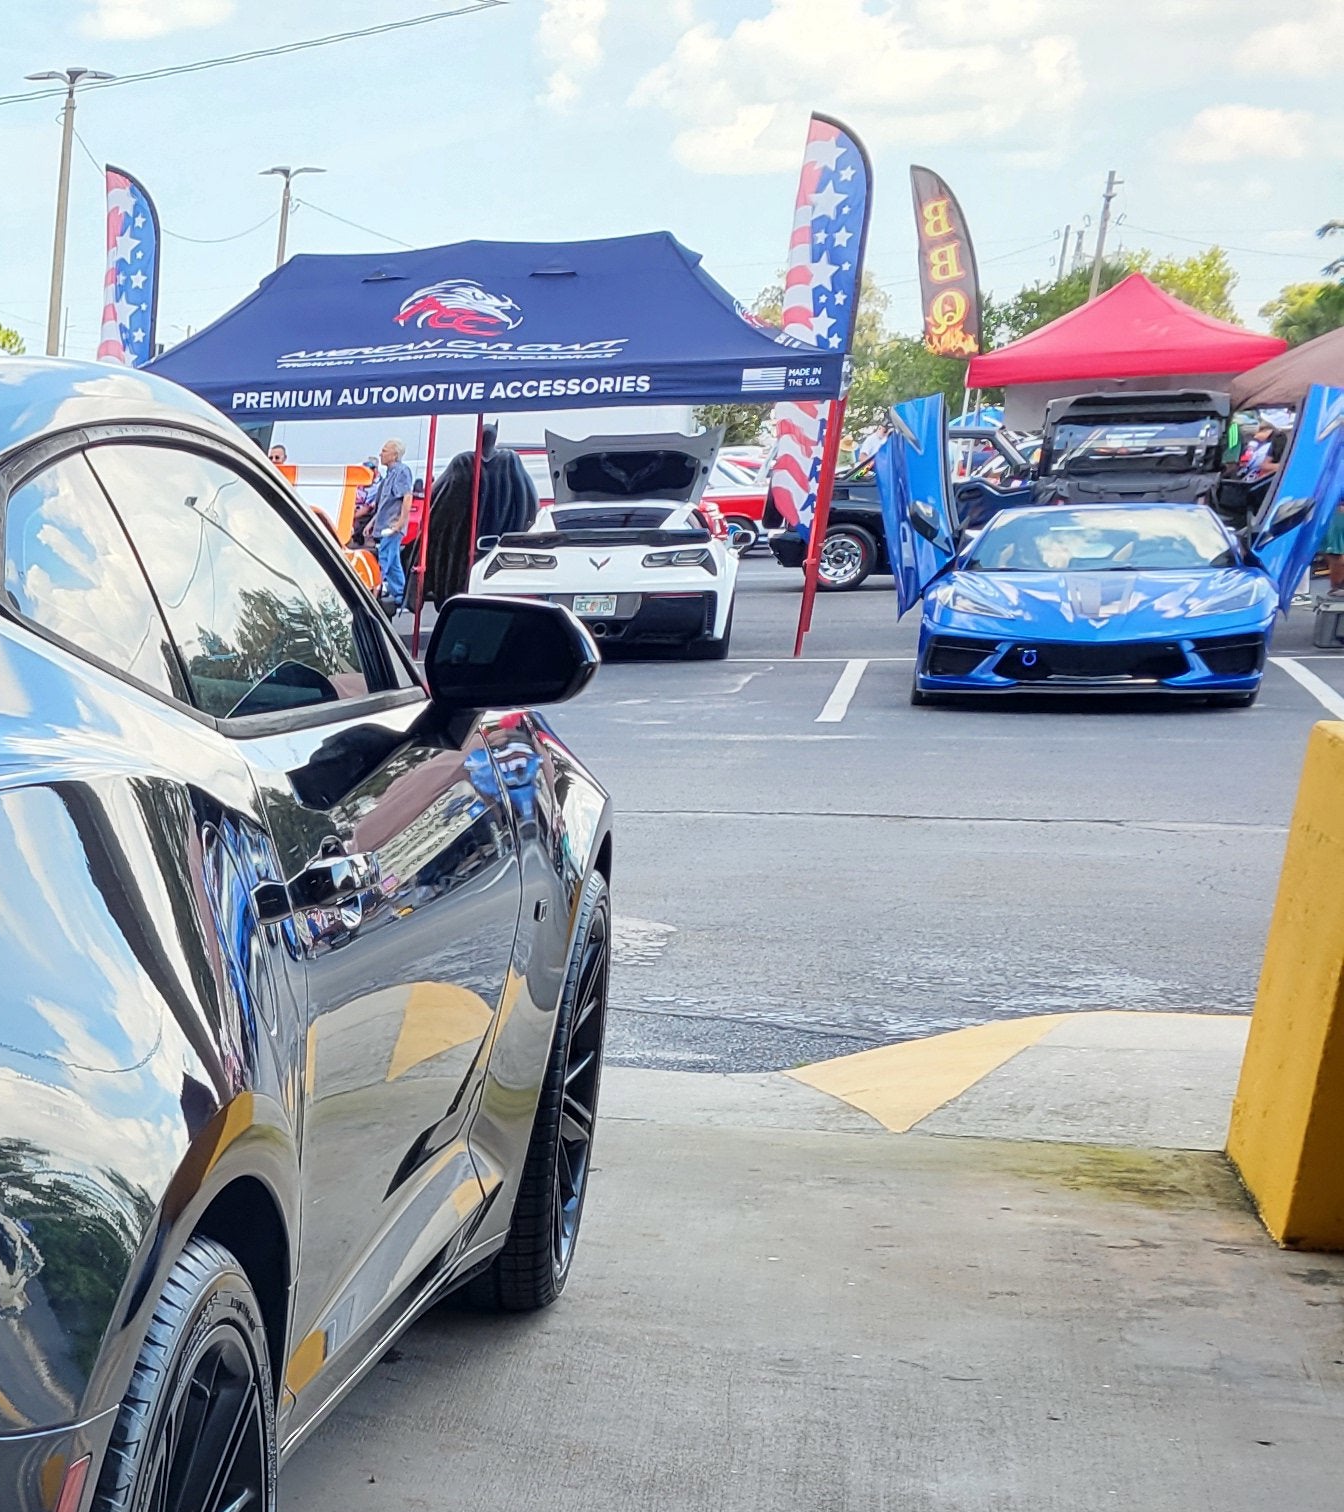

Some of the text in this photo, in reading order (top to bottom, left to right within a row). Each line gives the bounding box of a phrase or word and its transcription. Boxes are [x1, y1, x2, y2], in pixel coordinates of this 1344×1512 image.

[446, 339, 514, 351] CAR
[516, 338, 630, 351] CRAFT
[787, 366, 822, 377] MADE IN
[788, 377, 821, 387] THE USA
[231, 375, 651, 409] PREMIUM AUTOMOTIVE ACCESSORIES
